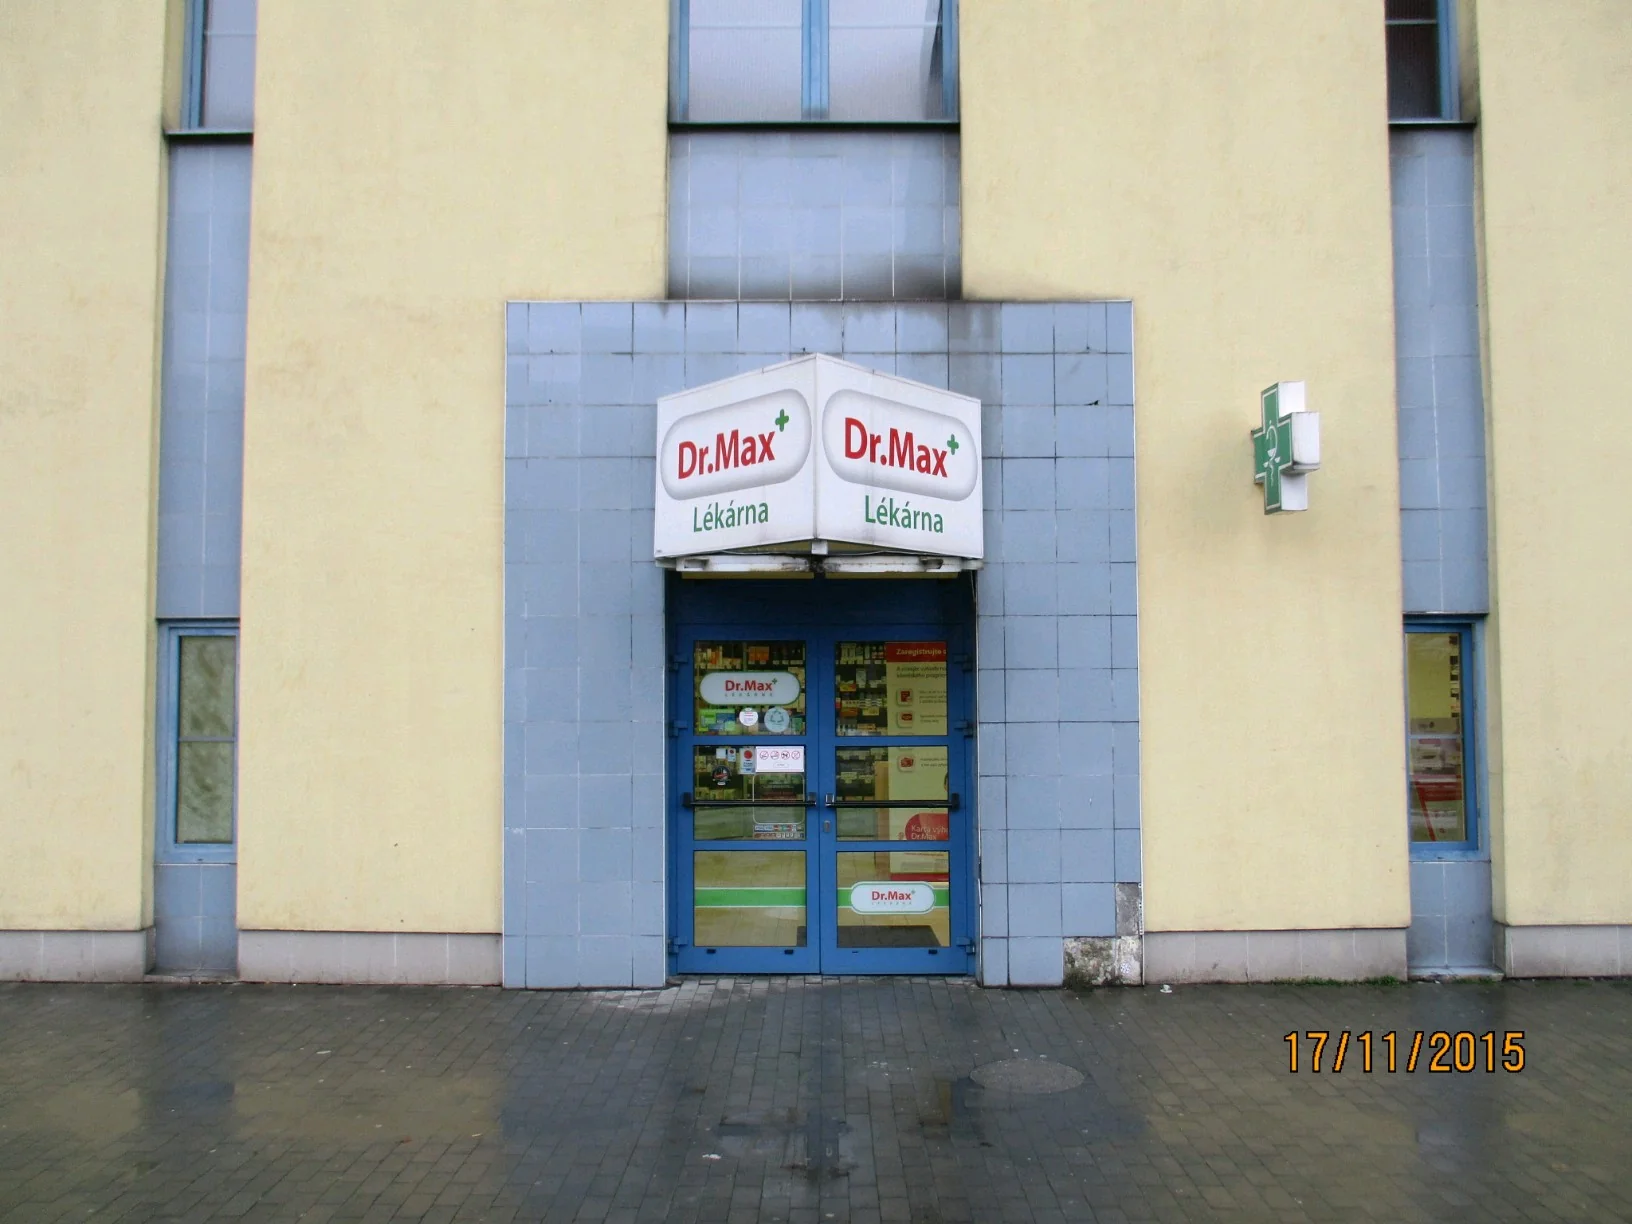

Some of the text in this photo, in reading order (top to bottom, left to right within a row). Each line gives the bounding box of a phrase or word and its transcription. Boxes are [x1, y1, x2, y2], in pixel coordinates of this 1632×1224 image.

[678, 429, 775, 480] Dr.Max
[844, 417, 948, 478] Dr.Max
[693, 500, 769, 533] Lékárna
[865, 494, 943, 533] Lékárna
[725, 680, 772, 691] Dr.Max
[872, 891, 912, 901] Dr.Max
